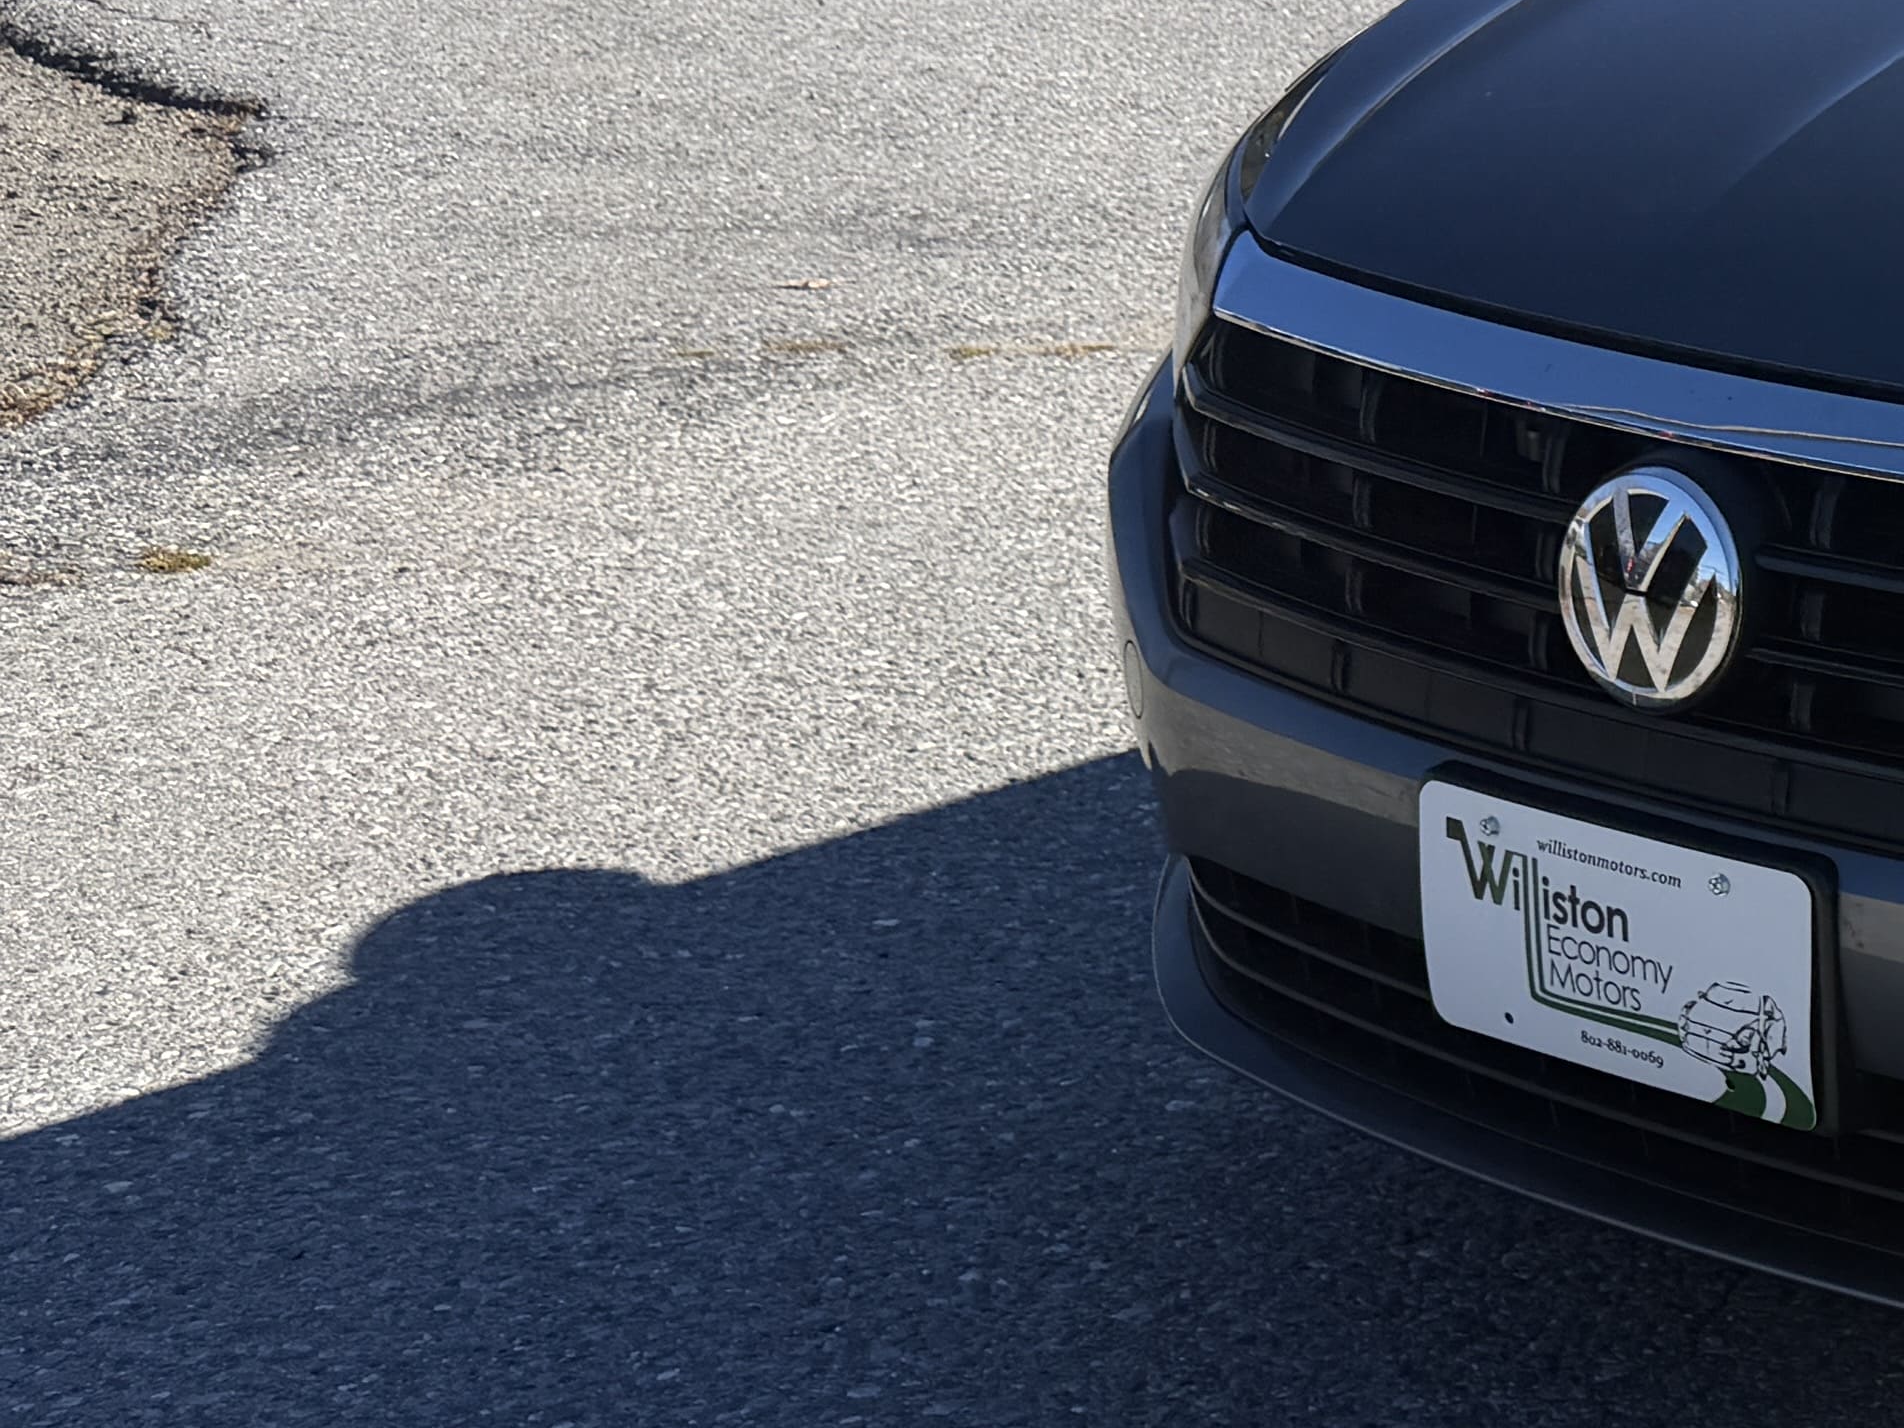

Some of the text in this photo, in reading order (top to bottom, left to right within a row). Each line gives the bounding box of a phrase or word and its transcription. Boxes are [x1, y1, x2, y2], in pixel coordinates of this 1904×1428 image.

[1560, 470, 1740, 702] VW
[1445, 816, 1630, 943] Williston
[1536, 839, 1683, 889] willistonmotors.com
[1546, 924, 1674, 994] Economy
[1549, 958, 1643, 1012] Motors
[1580, 1029, 1665, 1069] 802-881-0069
